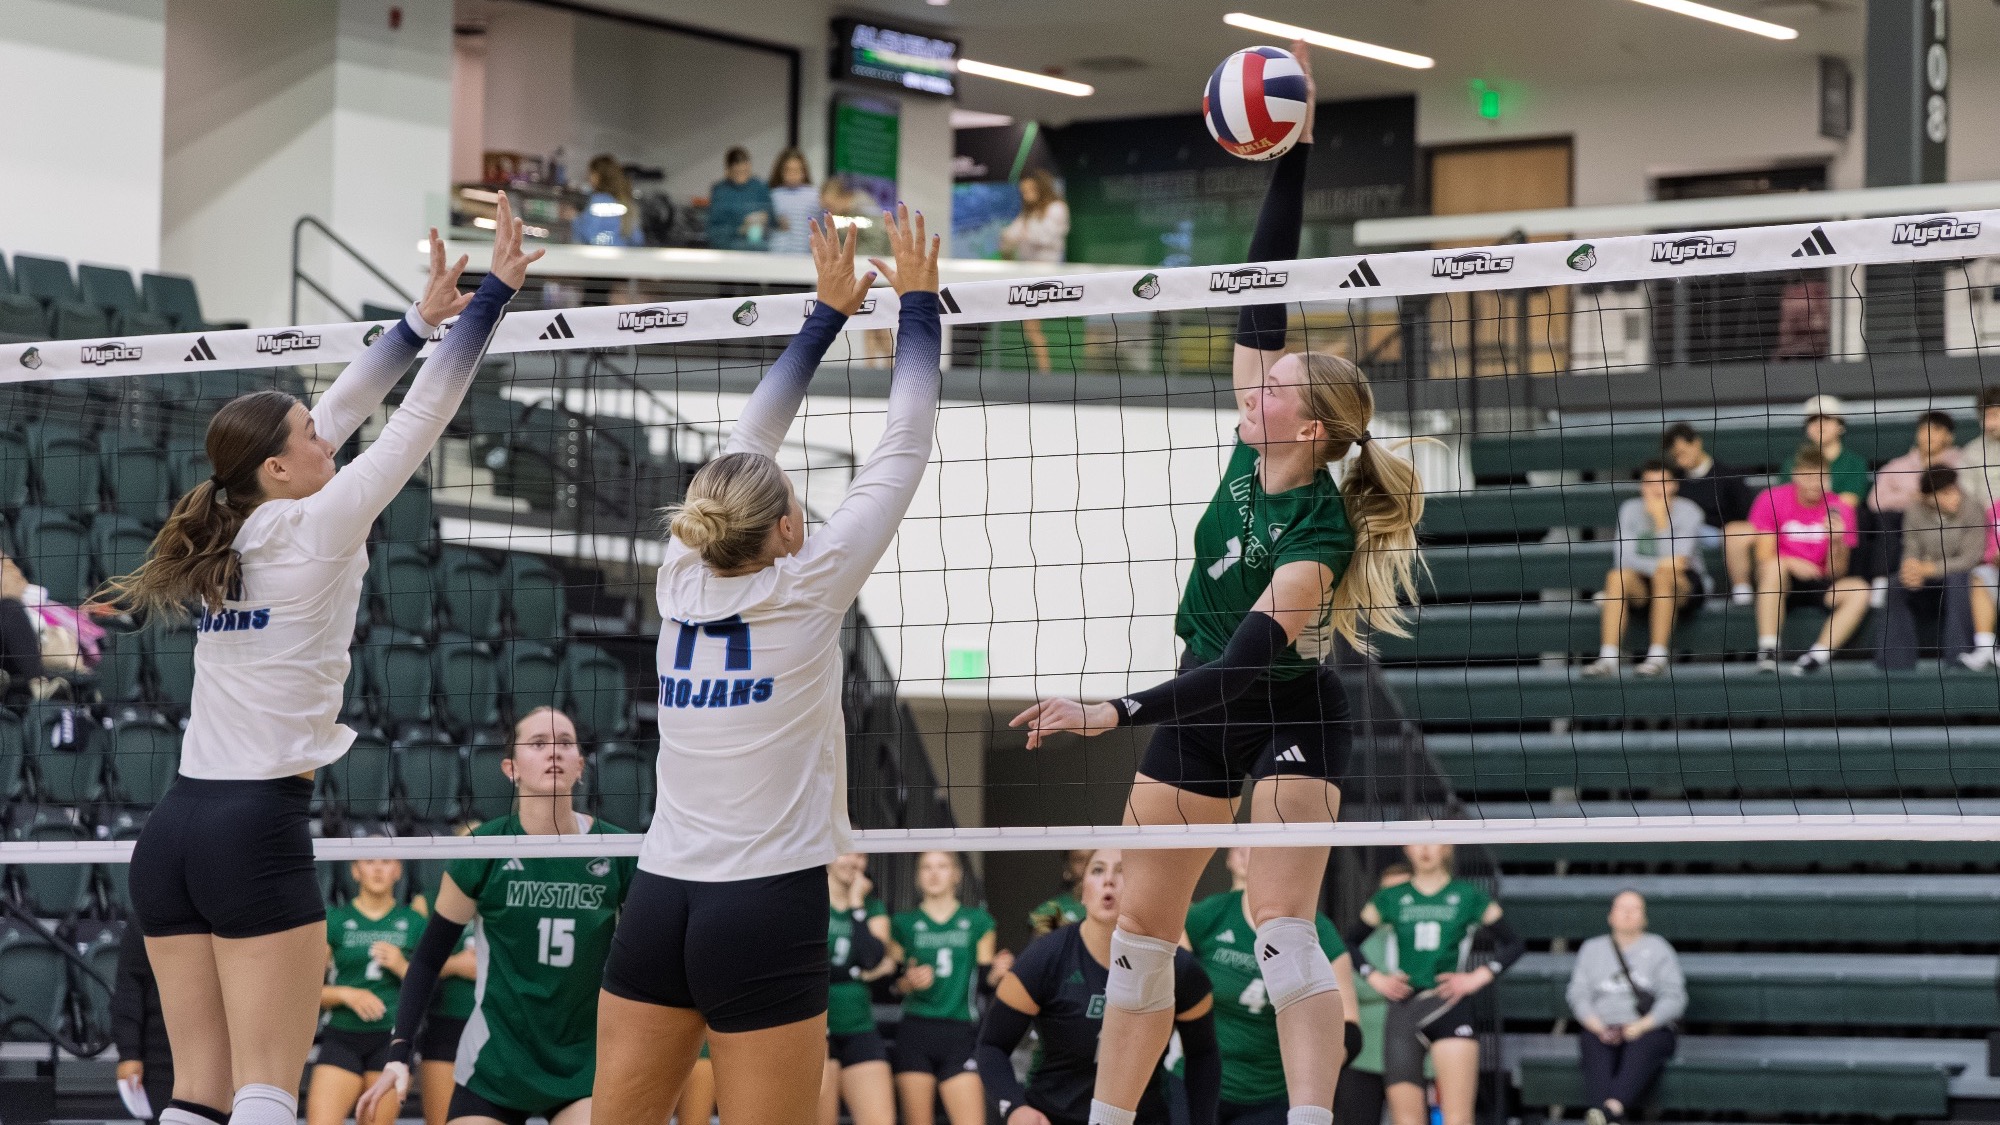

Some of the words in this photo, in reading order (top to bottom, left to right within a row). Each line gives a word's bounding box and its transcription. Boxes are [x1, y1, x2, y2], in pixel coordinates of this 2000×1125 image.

[1926, 0, 1948, 143] 108
[1234, 137, 1275, 155] NAIA
[1892, 220, 1981, 246] Mystics
[1651, 239, 1736, 264] Mystics
[1431, 254, 1514, 279] Mystics
[1209, 268, 1288, 293] Mystics
[1008, 283, 1083, 307] Mystics
[618, 308, 687, 332] Mystics
[81, 344, 143, 365] Mystics
[257, 332, 321, 354] Mystics
[199, 607, 271, 632] OJANS
[506, 880, 606, 910] MYSTICS
[537, 917, 577, 968] 15
